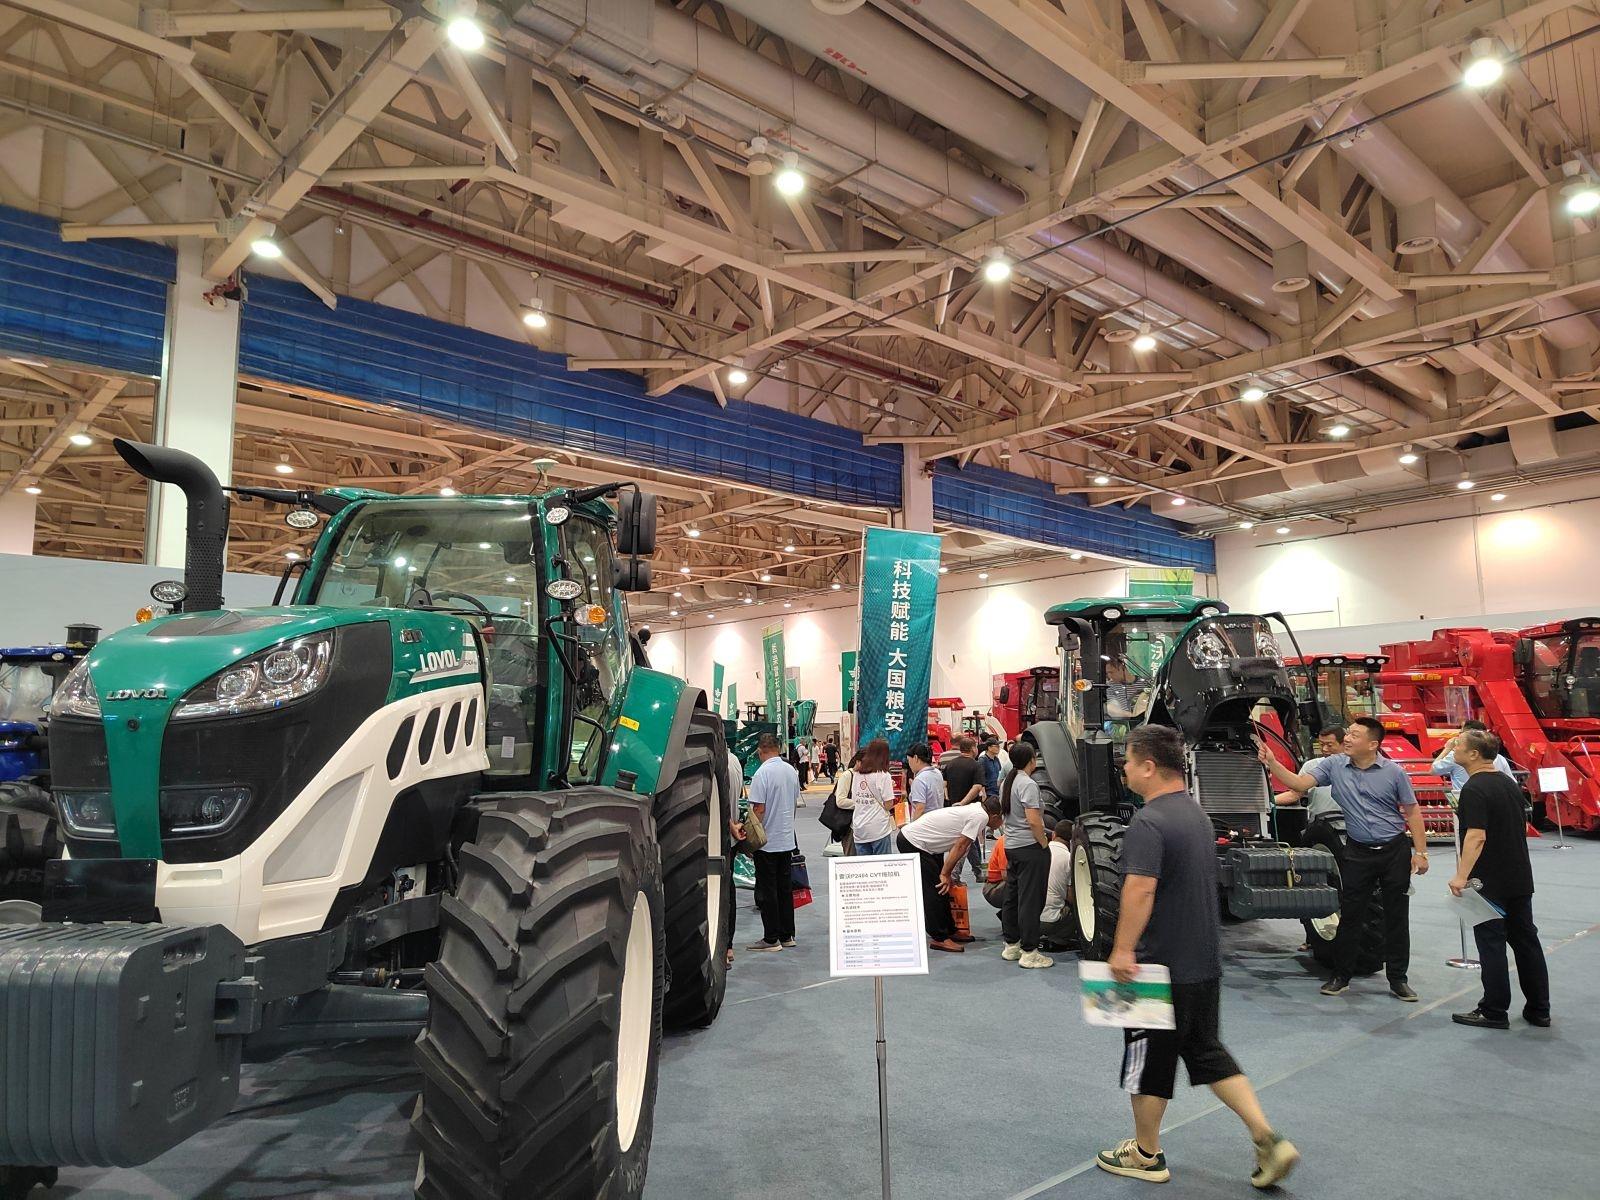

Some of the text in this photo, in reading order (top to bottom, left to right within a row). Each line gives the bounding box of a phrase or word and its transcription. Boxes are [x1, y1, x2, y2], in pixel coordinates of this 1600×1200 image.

[884, 560, 912, 732] 科技赋能 大国粮安
[419, 649, 460, 673] LOVOL
[105, 688, 168, 701] LOVOL
